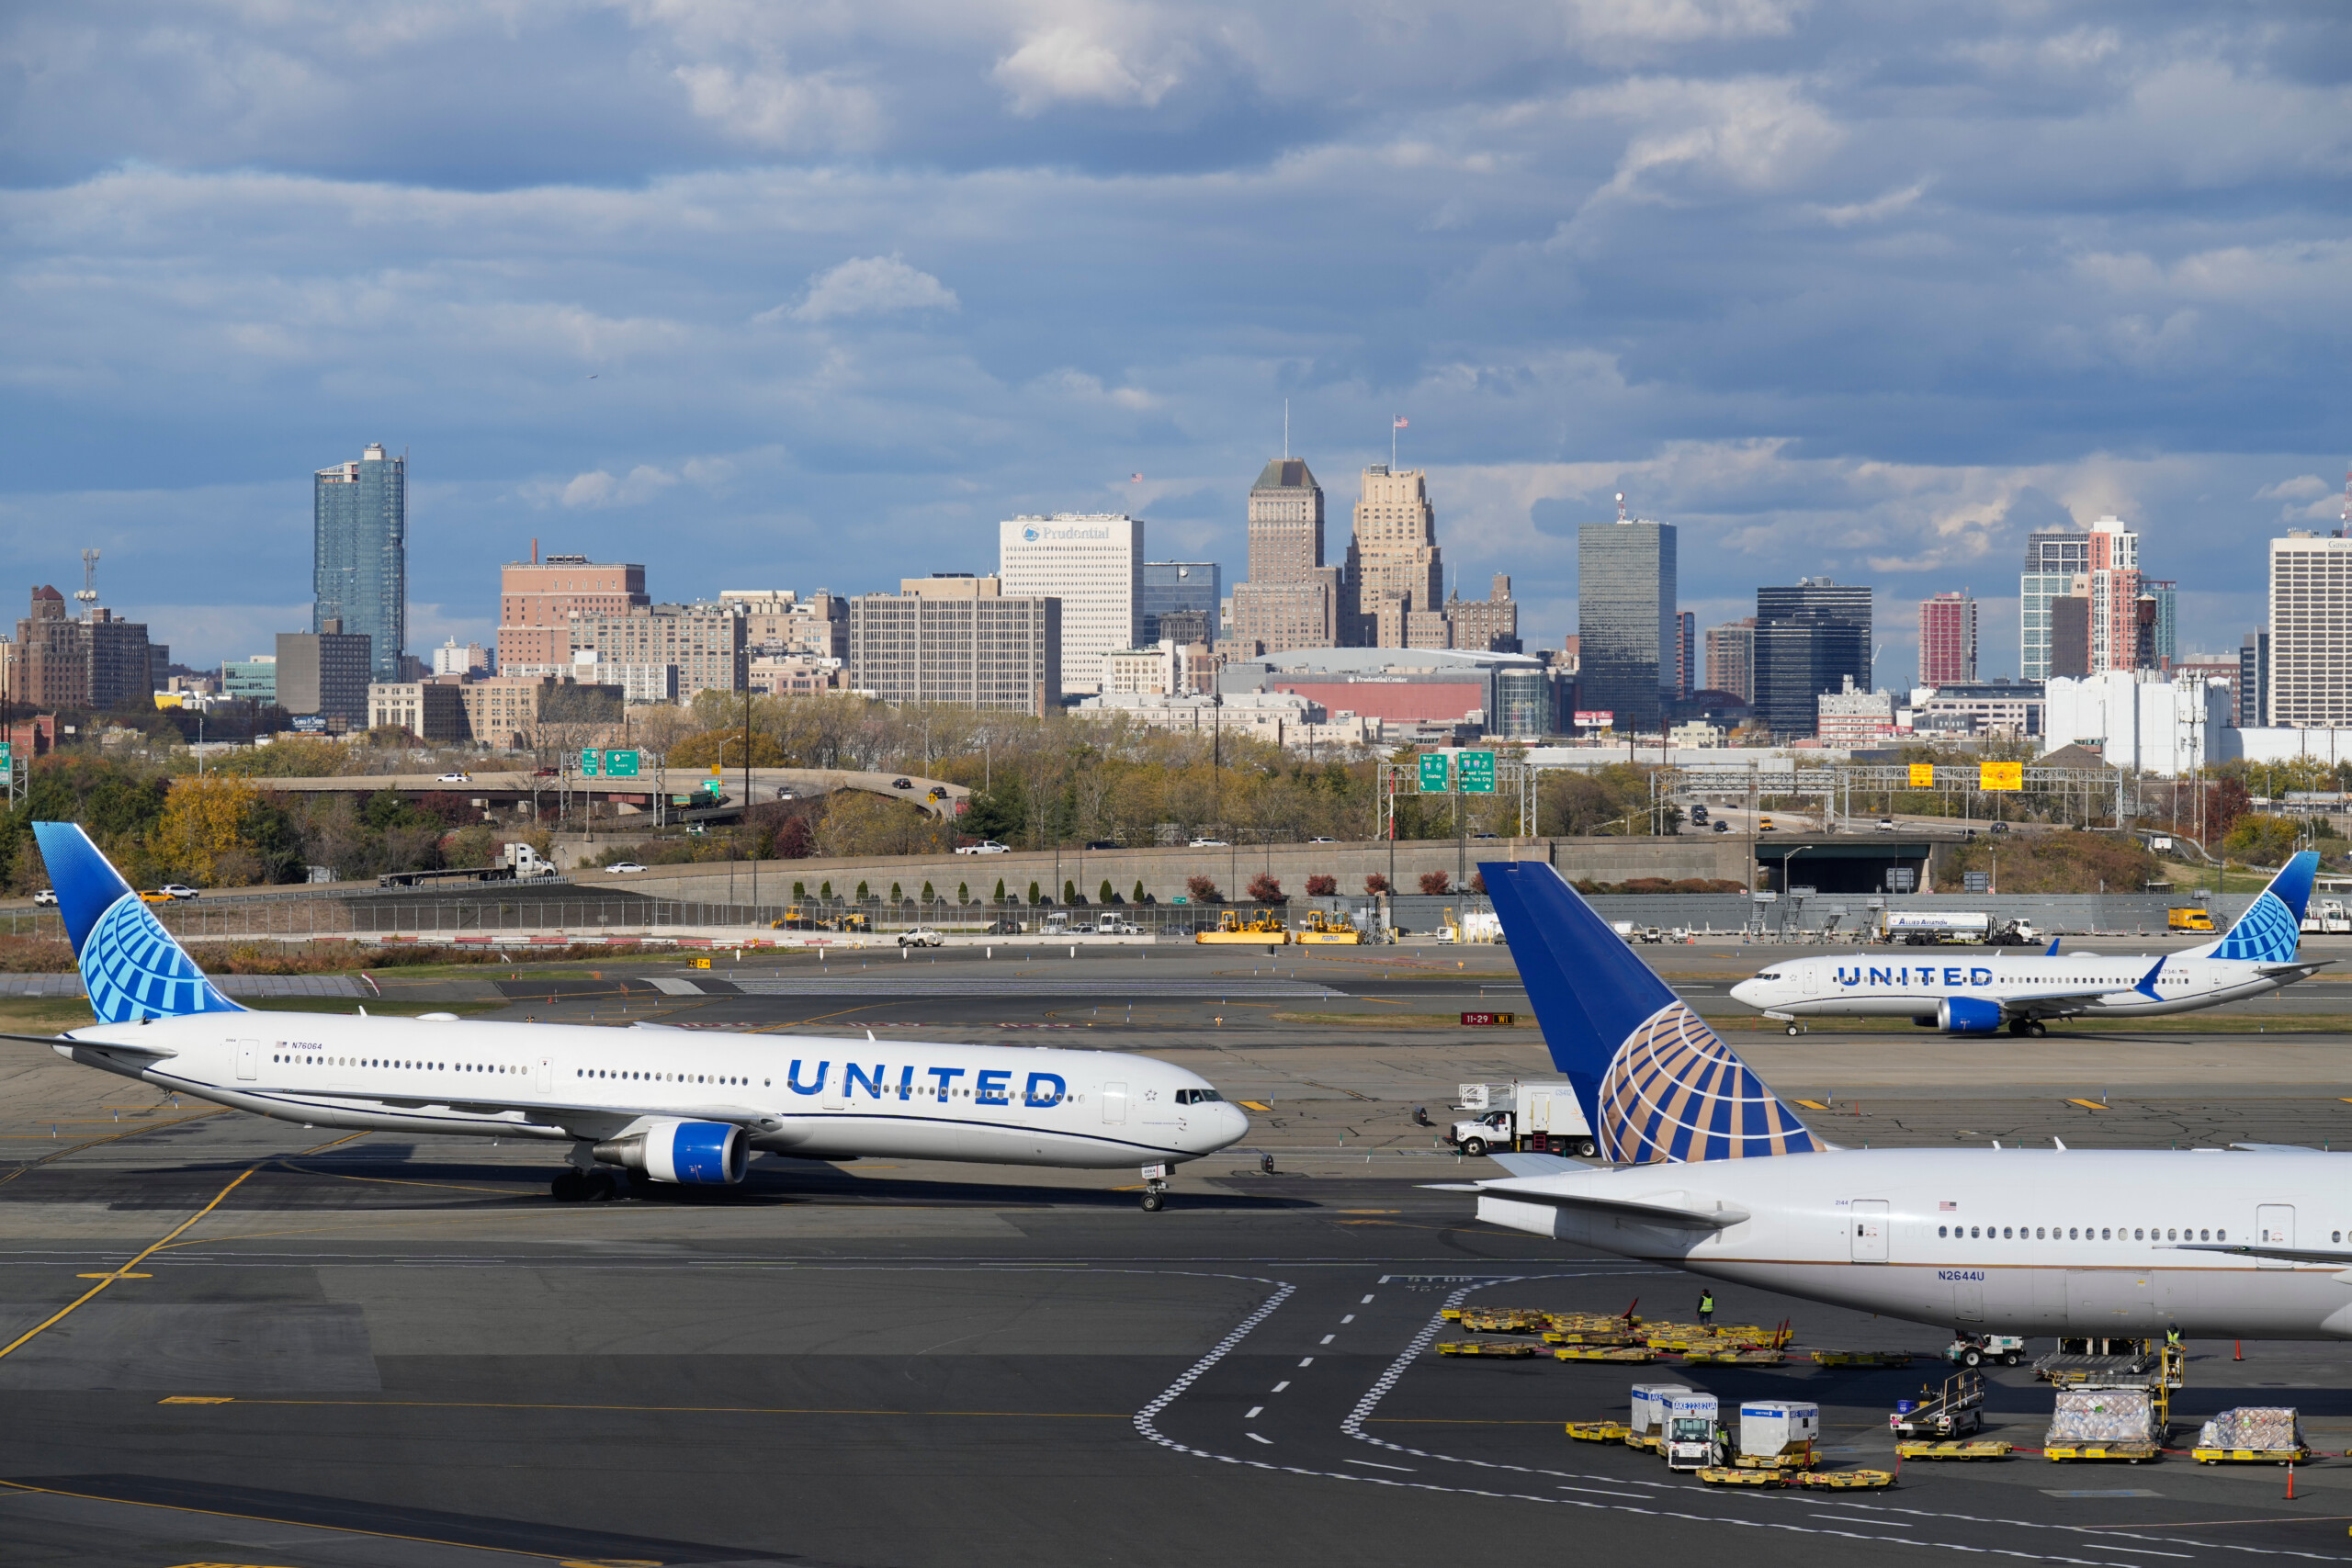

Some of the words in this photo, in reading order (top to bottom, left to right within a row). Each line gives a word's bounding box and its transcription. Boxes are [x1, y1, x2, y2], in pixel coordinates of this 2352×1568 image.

[1043, 526, 1110, 540] Prudential
[1838, 967, 1993, 987] UNITED
[1467, 1015, 1488, 1023] 11-29
[1498, 1015, 1509, 1023] W1
[292, 1042, 322, 1050] N76064
[787, 1059, 1067, 1108] UNITED
[1555, 1089, 1572, 1097] CS412
[1939, 1270, 1984, 1281] N2644U
[1674, 1402, 1717, 1410] AKE22382UA
